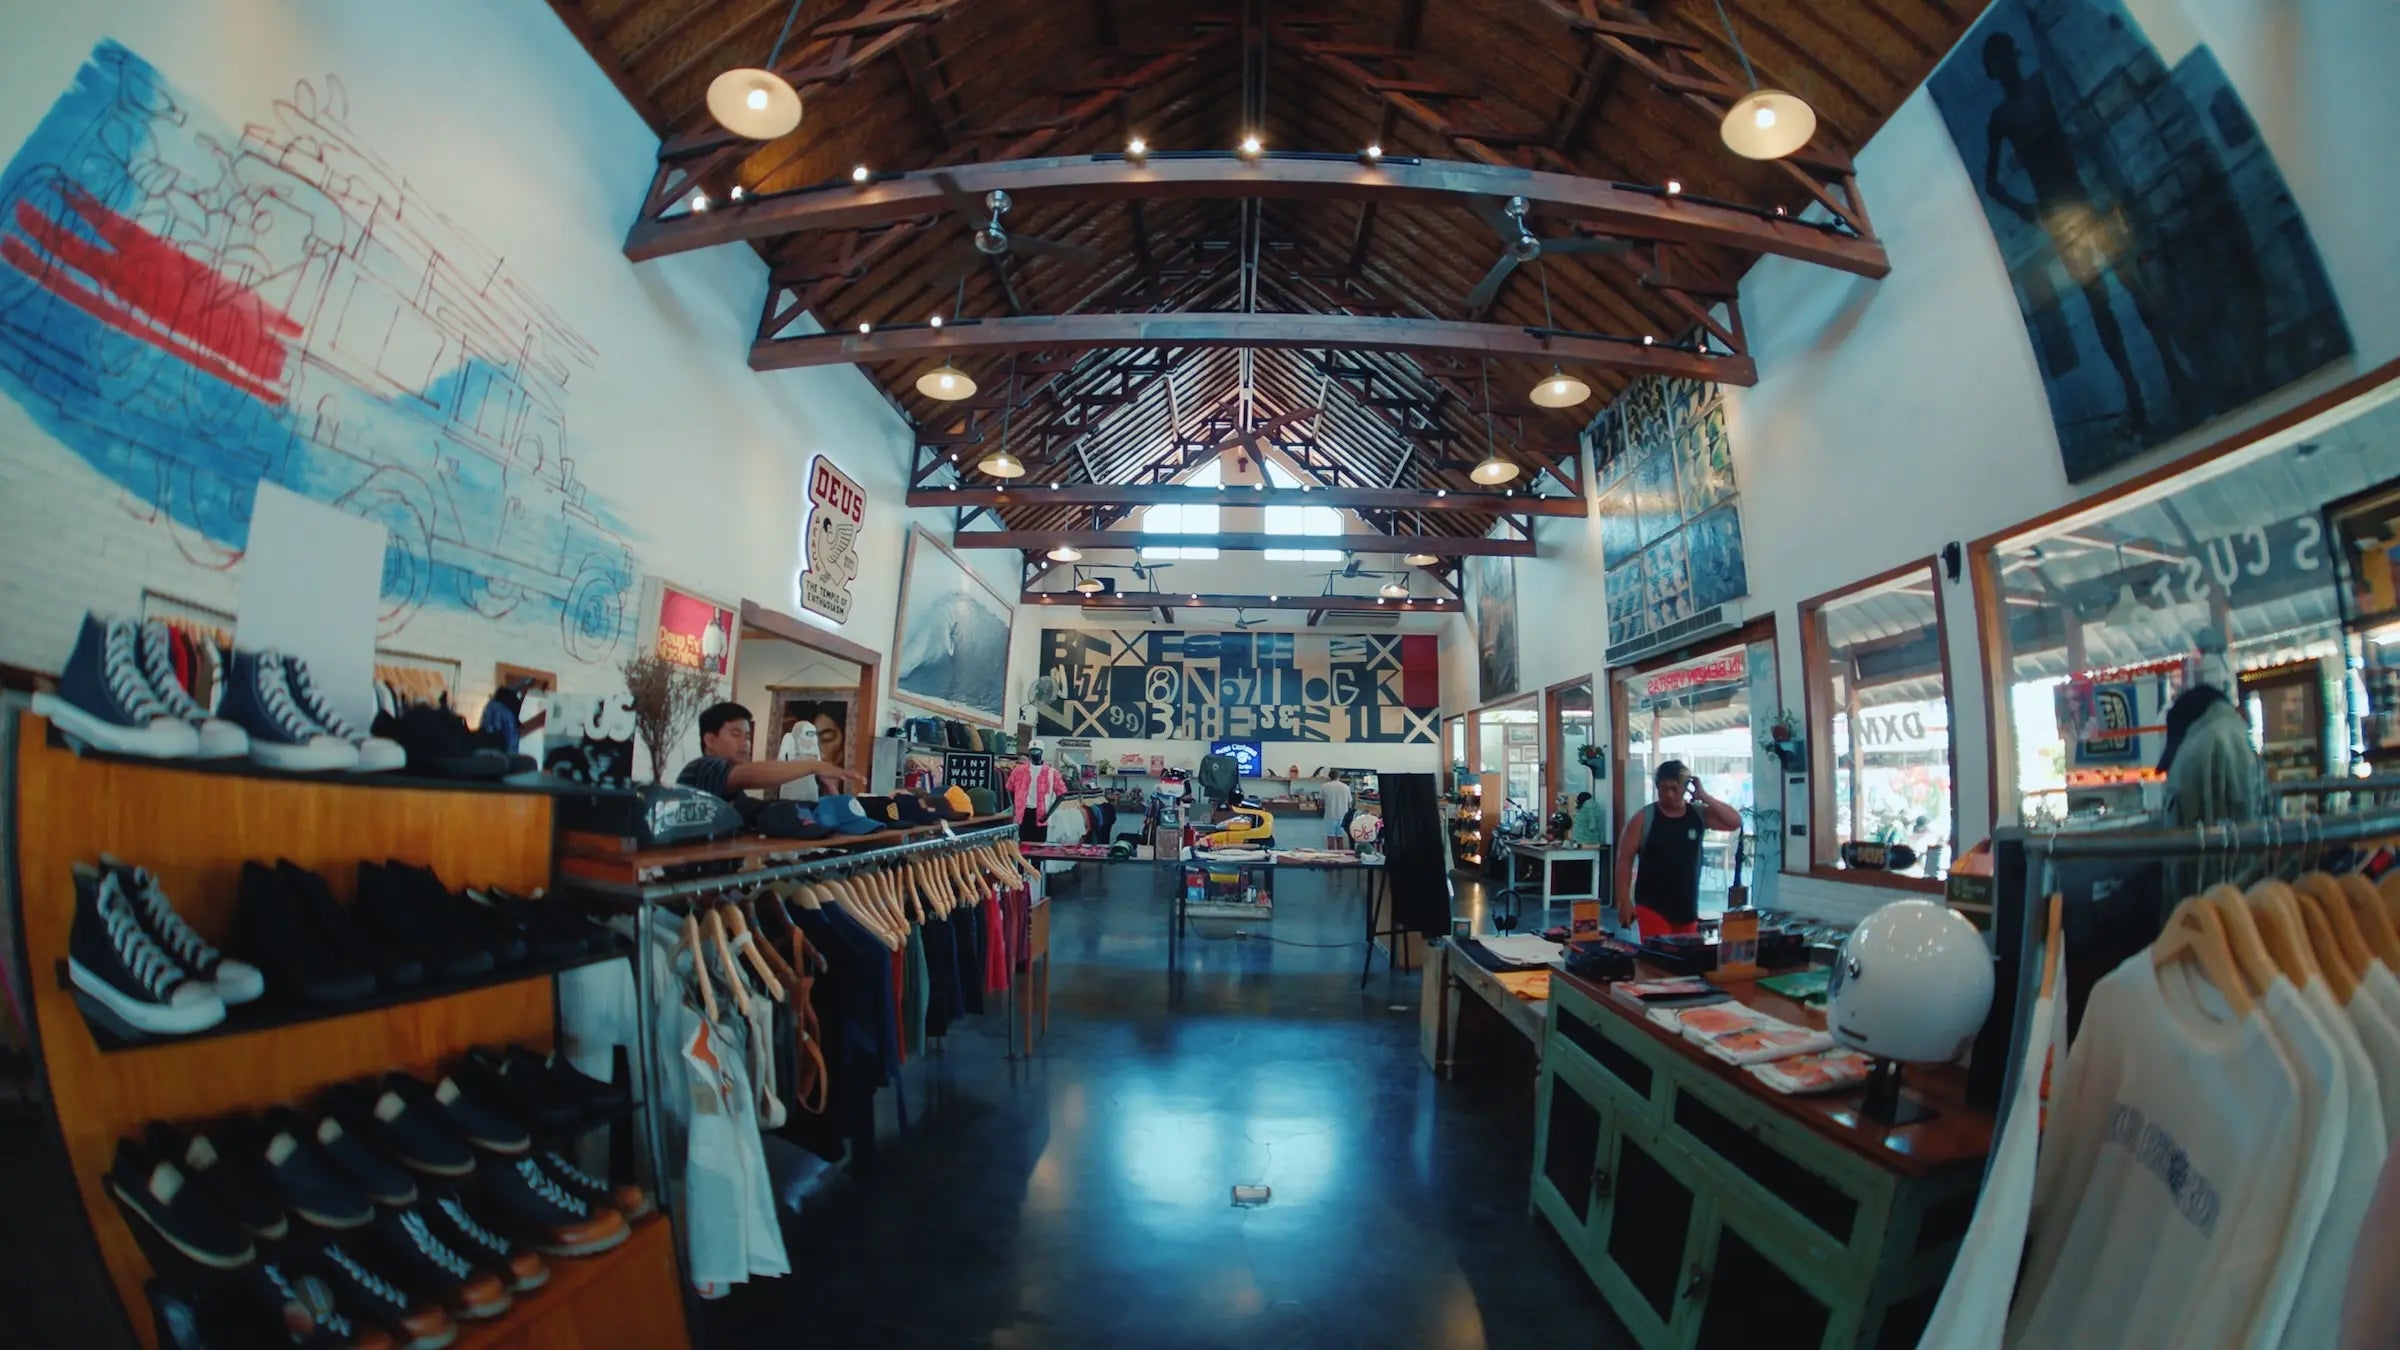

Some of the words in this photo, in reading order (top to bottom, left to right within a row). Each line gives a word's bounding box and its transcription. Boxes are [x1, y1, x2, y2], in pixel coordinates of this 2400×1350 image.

[816, 466, 862, 523] DEUS
[806, 580, 817, 592] THE
[820, 587, 839, 604] TEMPLE
[807, 592, 844, 616] ENTHUSIASM
[951, 758, 986, 768] TINY
[951, 768, 985, 777] WAVE
[950, 778, 985, 787] SURF
